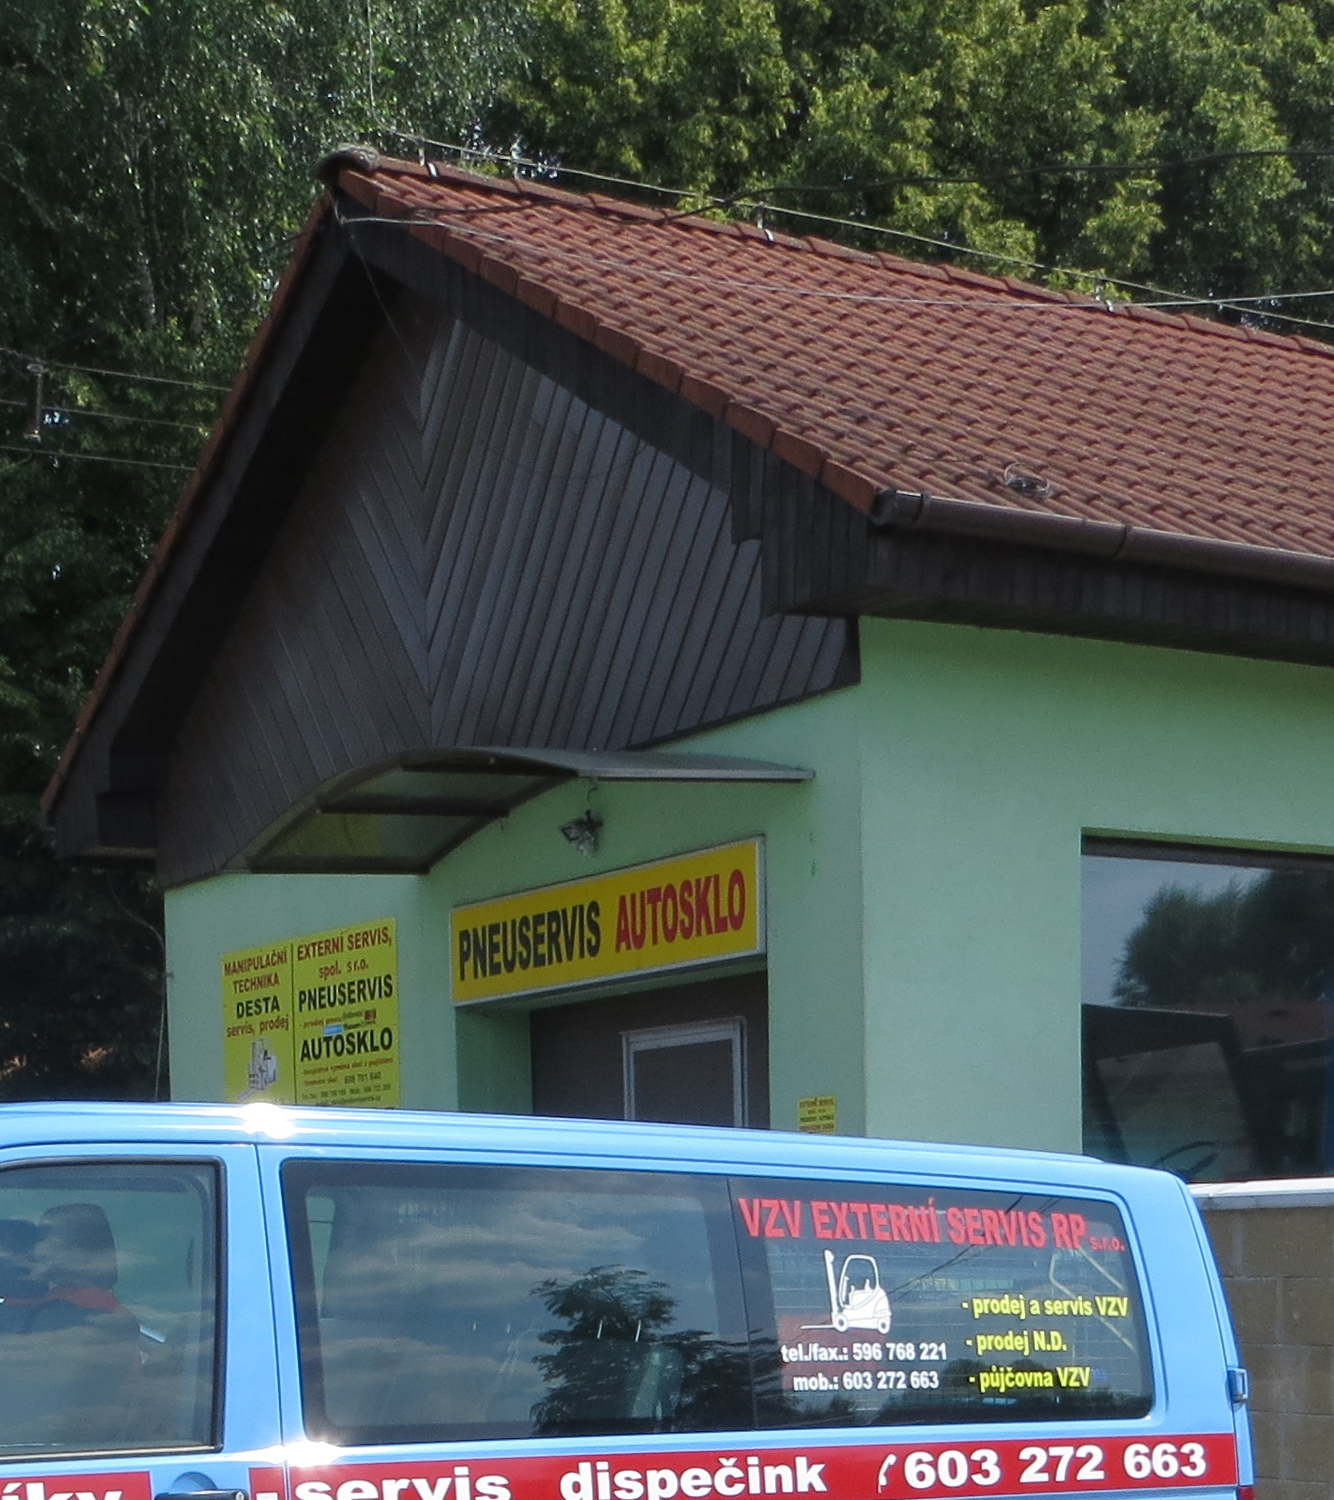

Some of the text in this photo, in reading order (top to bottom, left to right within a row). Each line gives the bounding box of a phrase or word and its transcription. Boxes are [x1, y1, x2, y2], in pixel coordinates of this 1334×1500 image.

[459, 869, 747, 982] PNEUSERVIS AUTOSKLO
[297, 926, 392, 961] EXTERNÍ SERVIS,
[224, 946, 288, 976] MANIPULAČNÍ
[318, 960, 341, 980] spol.
[233, 972, 280, 994] TECHNIKA
[298, 974, 393, 1012] PNEUSERVIS
[236, 995, 281, 1018] DESTA
[259, 1014, 289, 1034] prodej
[300, 1027, 393, 1062] AUTOSKLO
[738, 1197, 1126, 1251] VZV EXTERNÍ SERVIS RP s.r.o.
[972, 1294, 1026, 1319] prodej
[1029, 1299, 1041, 1315] a
[1044, 1296, 1093, 1316] servis
[1094, 1296, 1129, 1317] VZV
[780, 1342, 948, 1362] tel./fax.: 596 768 221
[976, 1330, 1030, 1356] prodej
[1033, 1330, 1068, 1351] N.D.
[793, 1371, 940, 1391] mob.: 603 272 663
[979, 1365, 1054, 1393] půjčovna
[1056, 1366, 1091, 1387] VZV
[903, 1449, 1002, 1489] 603
[1018, 1444, 1105, 1483] 272
[1123, 1442, 1207, 1479] 663
